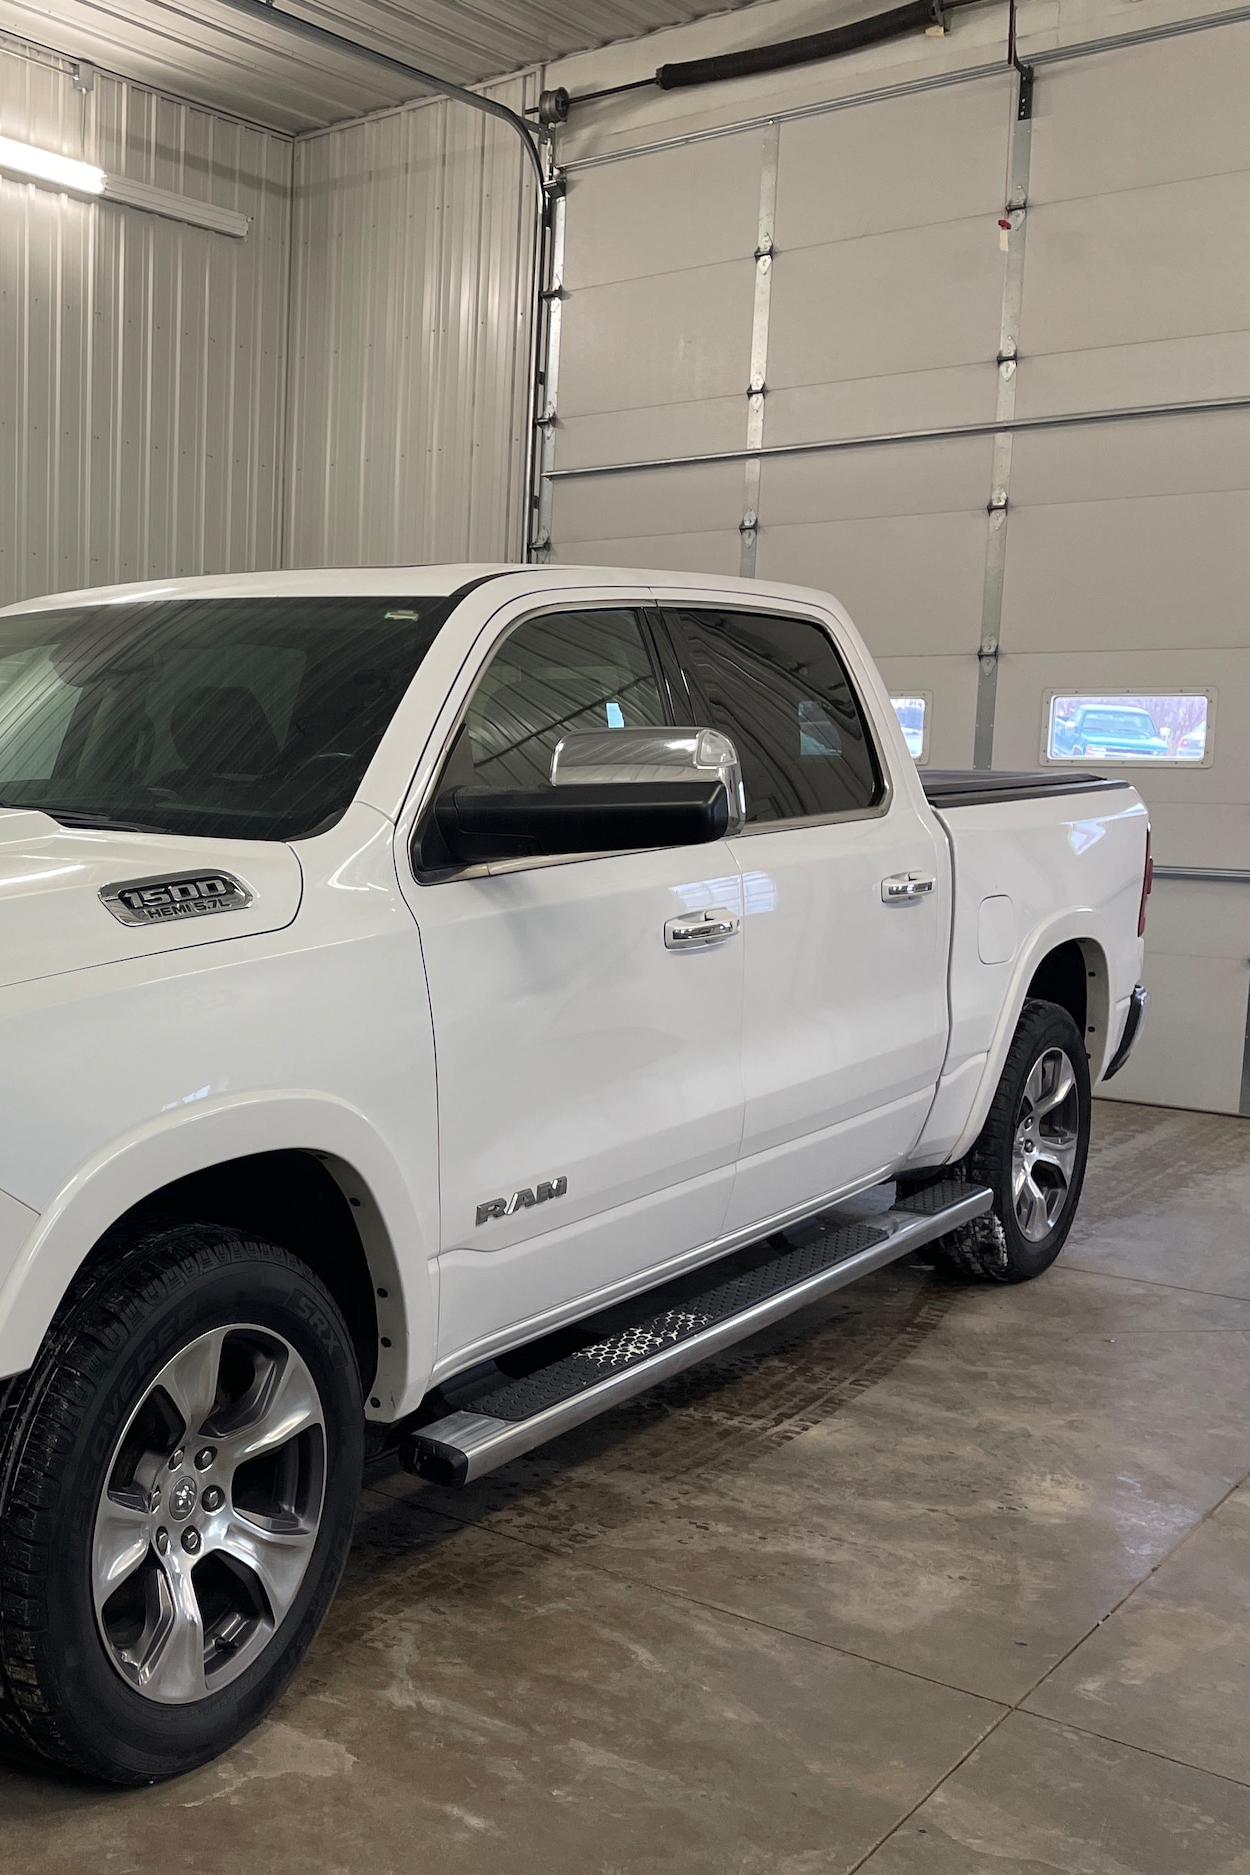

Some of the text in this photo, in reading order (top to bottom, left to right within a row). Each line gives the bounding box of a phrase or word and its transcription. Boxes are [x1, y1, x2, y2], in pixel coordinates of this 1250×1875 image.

[124, 879, 227, 908] 1500
[149, 899, 231, 919] HEMI 5.7L
[476, 1176, 567, 1226] RAM
